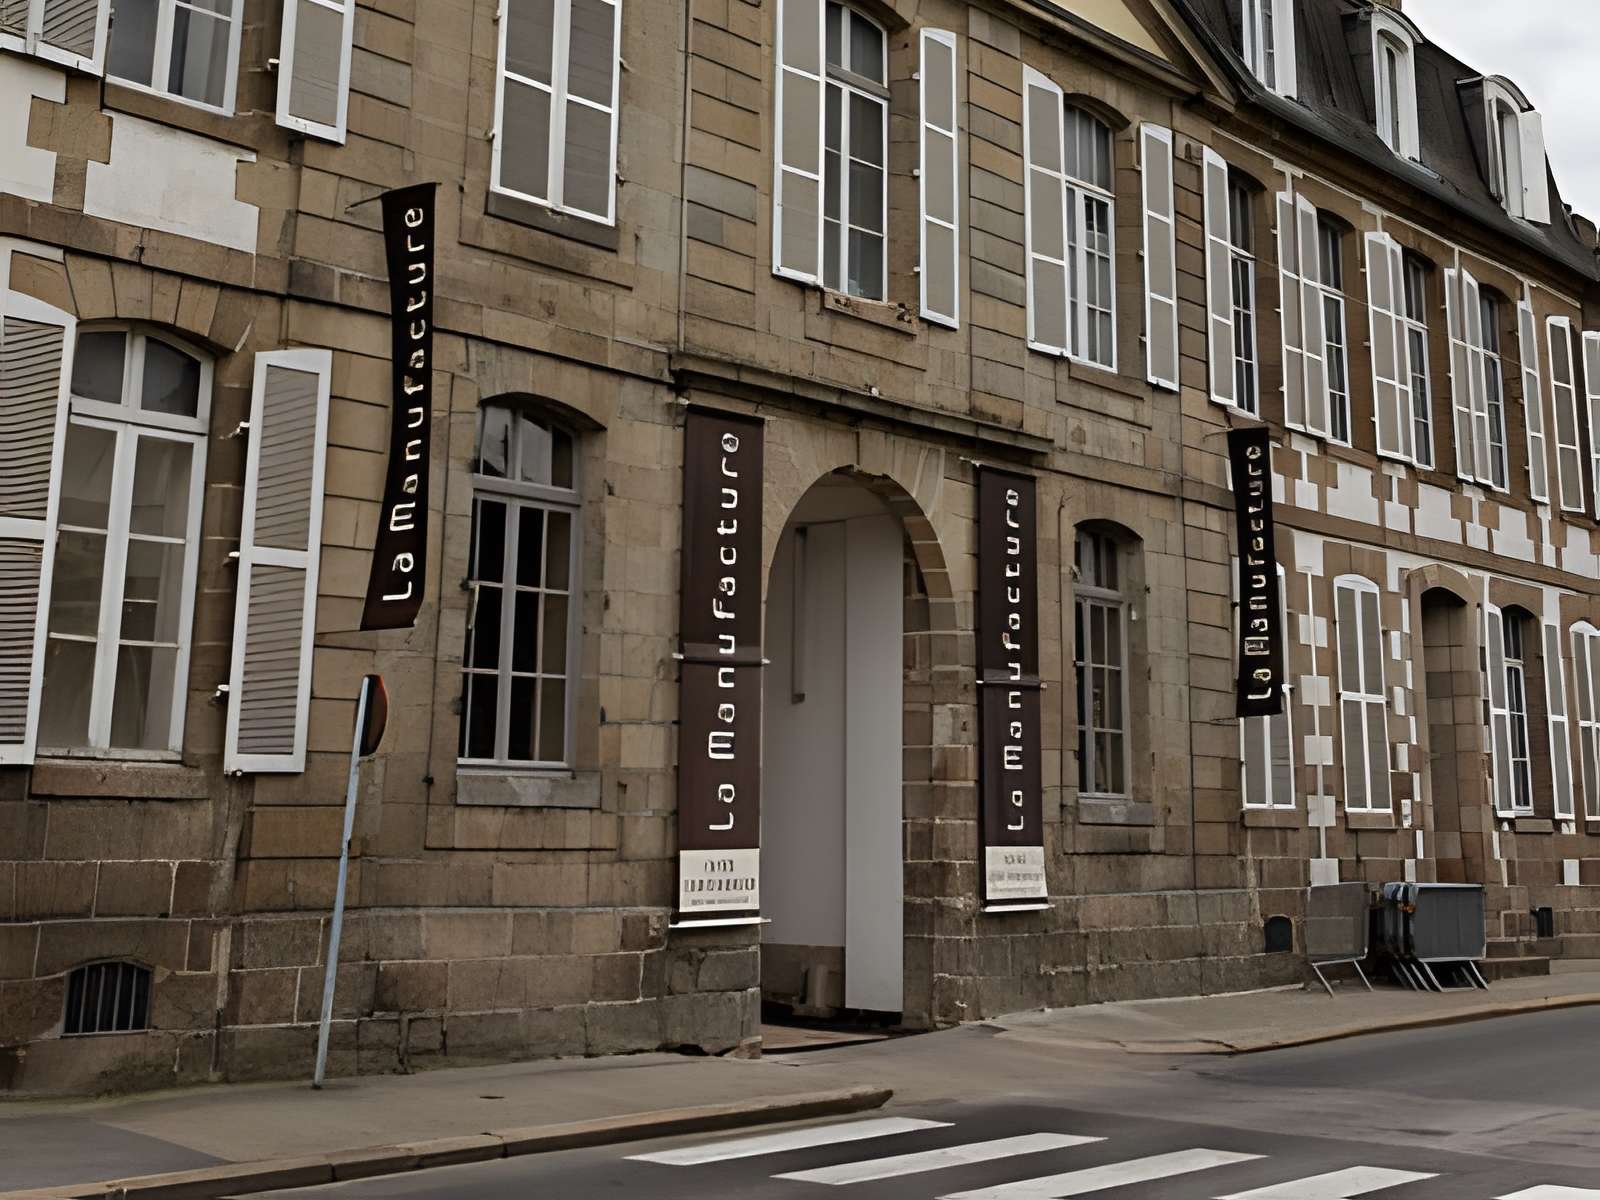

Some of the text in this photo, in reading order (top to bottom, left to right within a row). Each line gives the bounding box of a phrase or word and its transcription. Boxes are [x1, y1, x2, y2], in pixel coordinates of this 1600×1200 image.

[382, 206, 425, 601] La Manufacture
[708, 432, 739, 760] Manufacture
[1002, 489, 1023, 771] Manufacture
[708, 784, 735, 832] La
[1007, 790, 1024, 832] La
